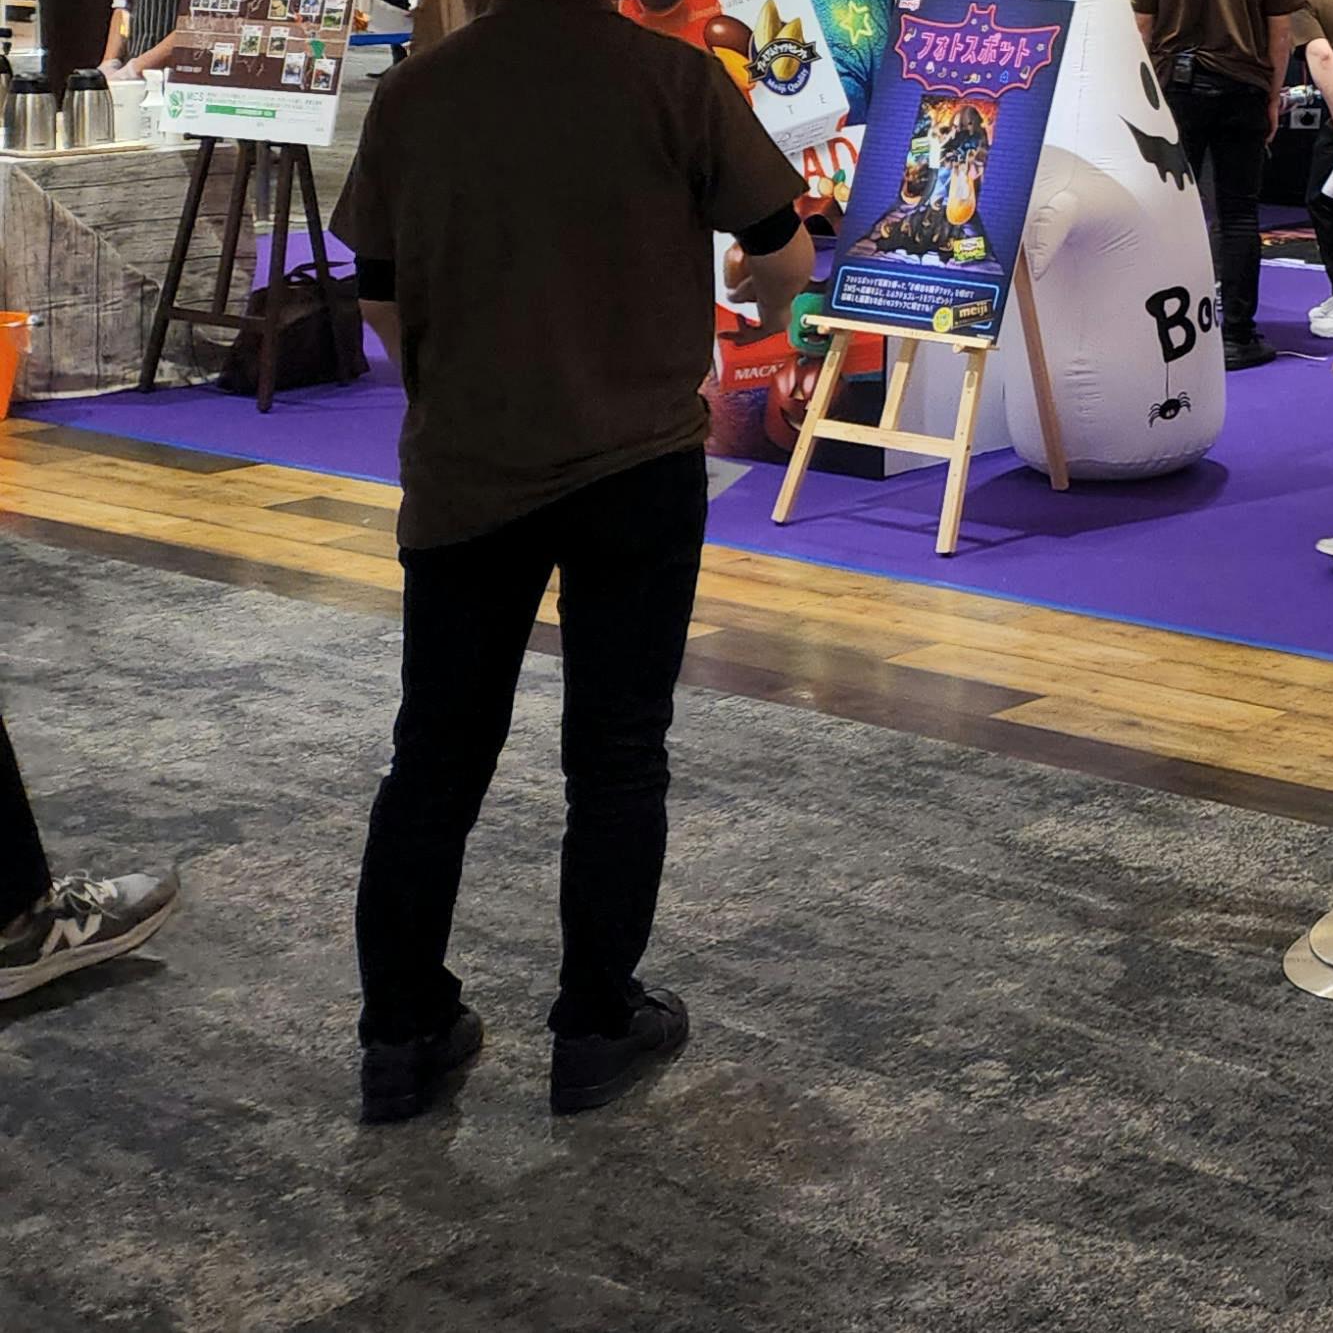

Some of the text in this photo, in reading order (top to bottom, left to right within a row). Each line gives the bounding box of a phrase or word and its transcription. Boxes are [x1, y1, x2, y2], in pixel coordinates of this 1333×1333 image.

[917, 32, 1031, 67] フォトスポット
